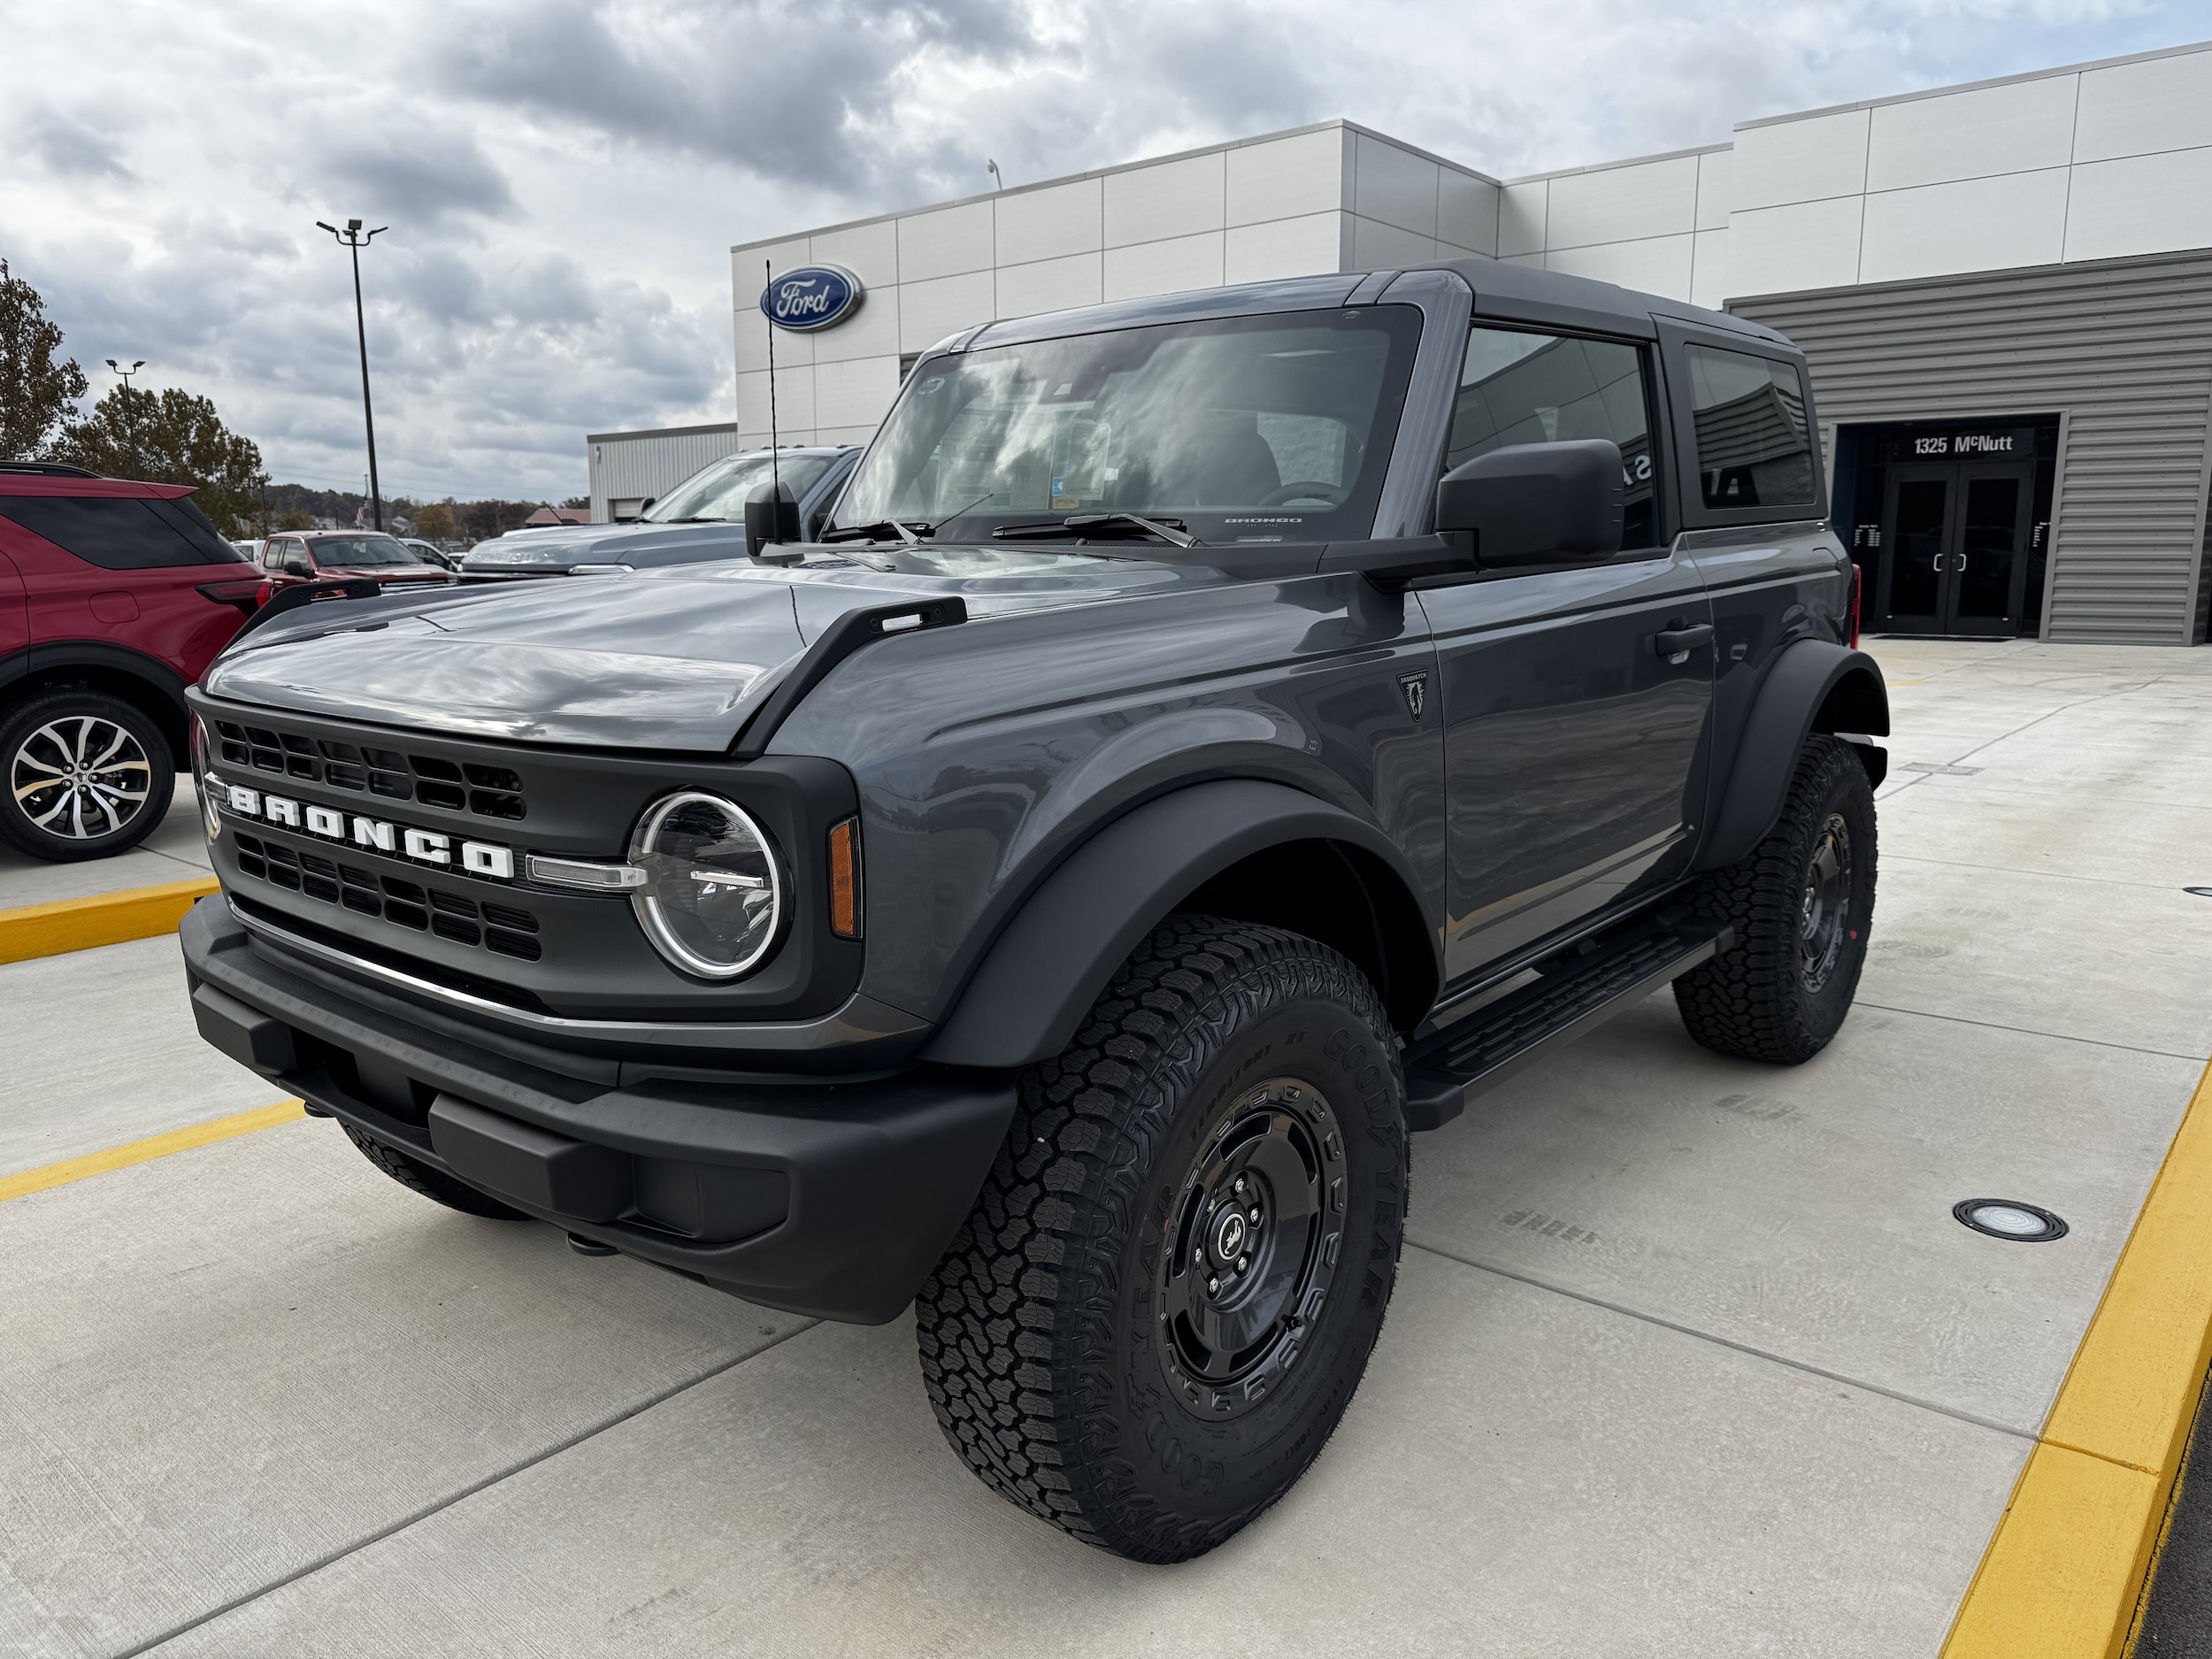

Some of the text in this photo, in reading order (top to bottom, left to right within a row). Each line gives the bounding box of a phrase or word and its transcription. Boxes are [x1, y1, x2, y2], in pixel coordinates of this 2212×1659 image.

[776, 279, 830, 319] Ford
[1915, 437, 1947, 454] 1325
[1401, 672, 1426, 683] SASQUATCH
[228, 783, 516, 879] BRONCO
